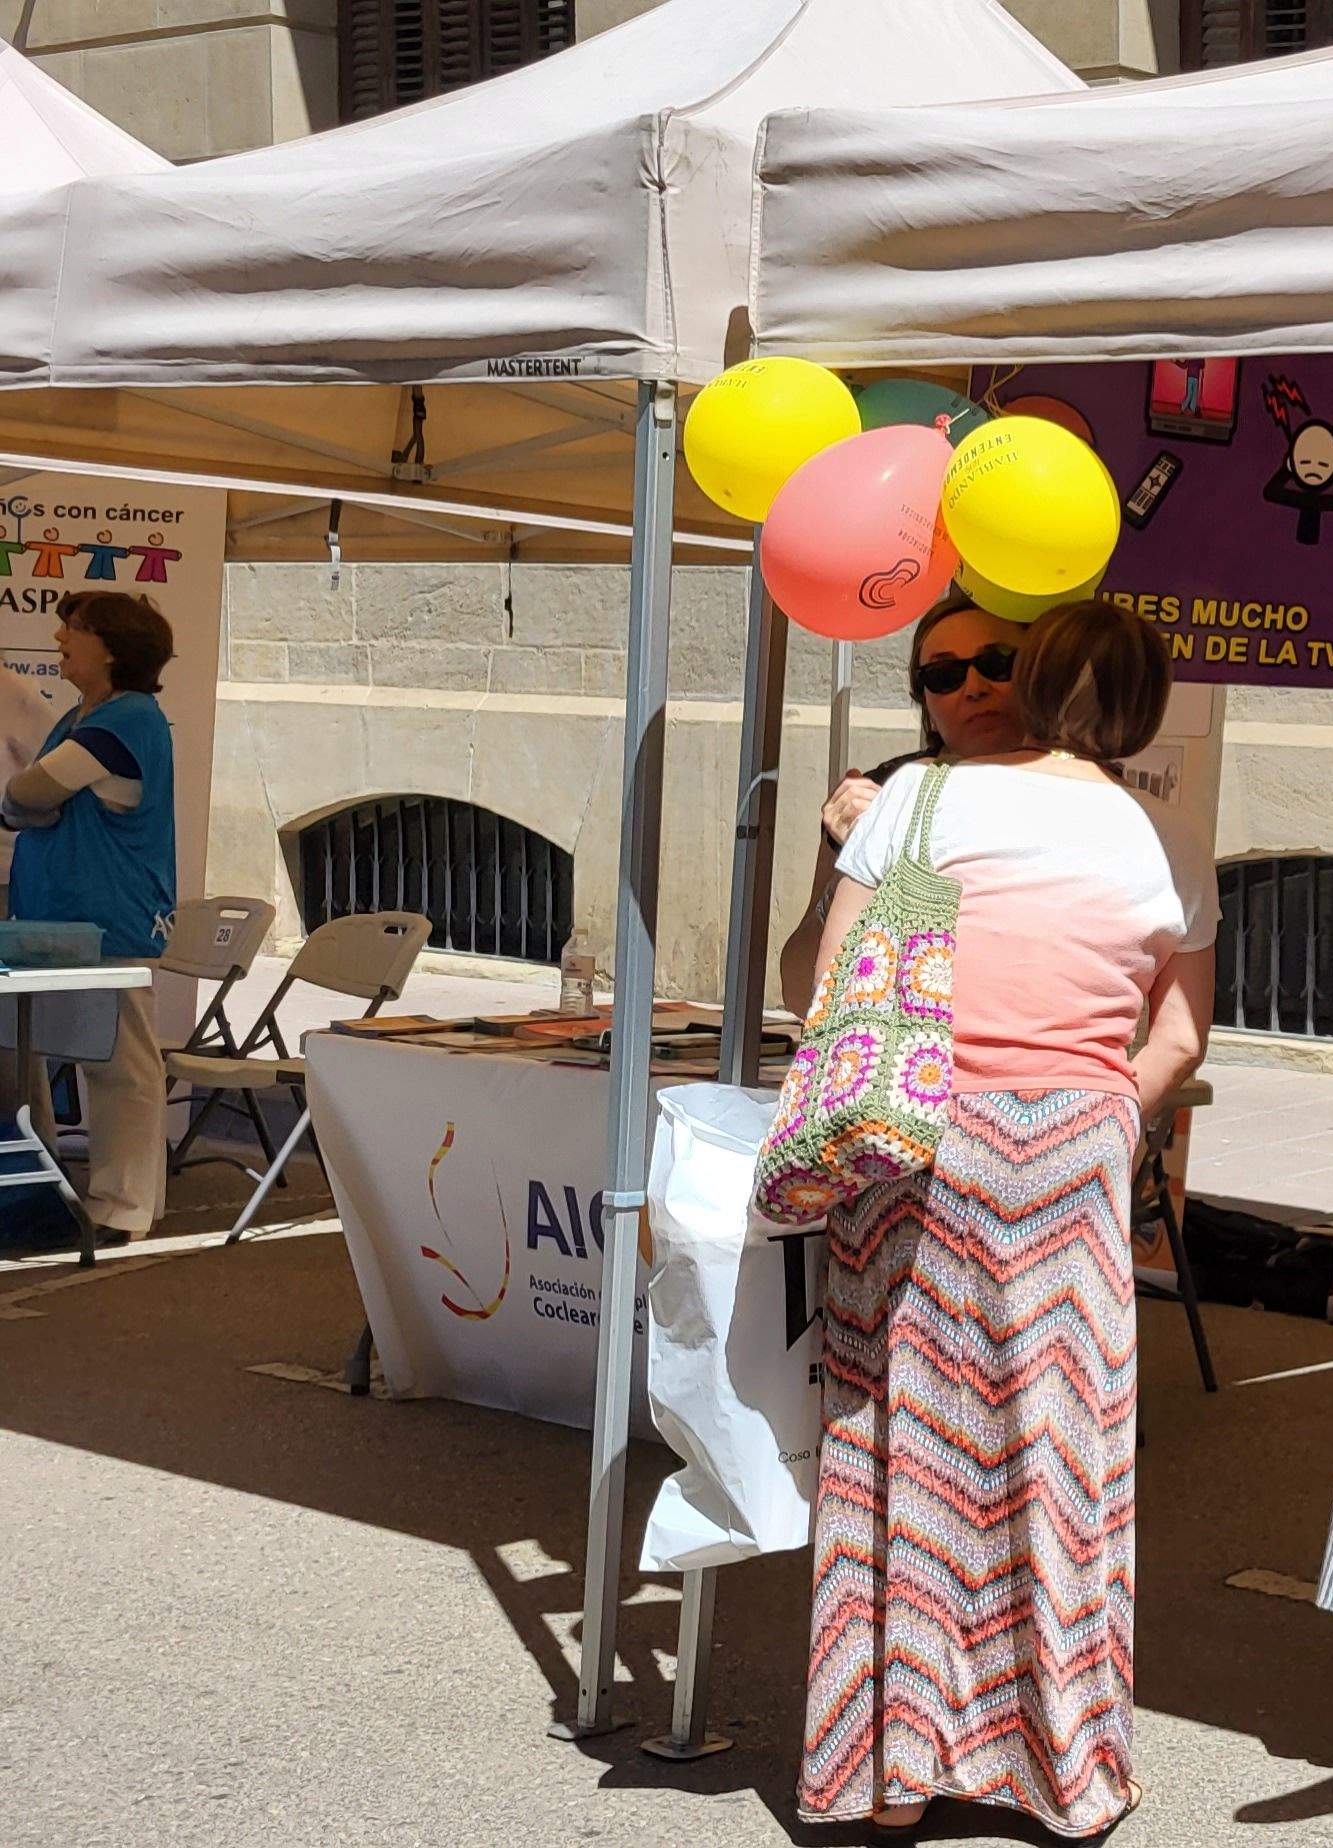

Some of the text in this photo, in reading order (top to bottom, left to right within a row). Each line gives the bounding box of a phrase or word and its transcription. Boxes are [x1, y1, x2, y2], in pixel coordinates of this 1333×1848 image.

[487, 358, 582, 377] MASTERTENT
[53, 505, 97, 520] con
[105, 503, 186, 523] cáncer
[1191, 599, 1309, 632] MUCHO
[1205, 635, 1249, 663] DE
[1258, 639, 1298, 665] LA
[216, 928, 231, 942] 28
[529, 1274, 596, 1300] Asociación
